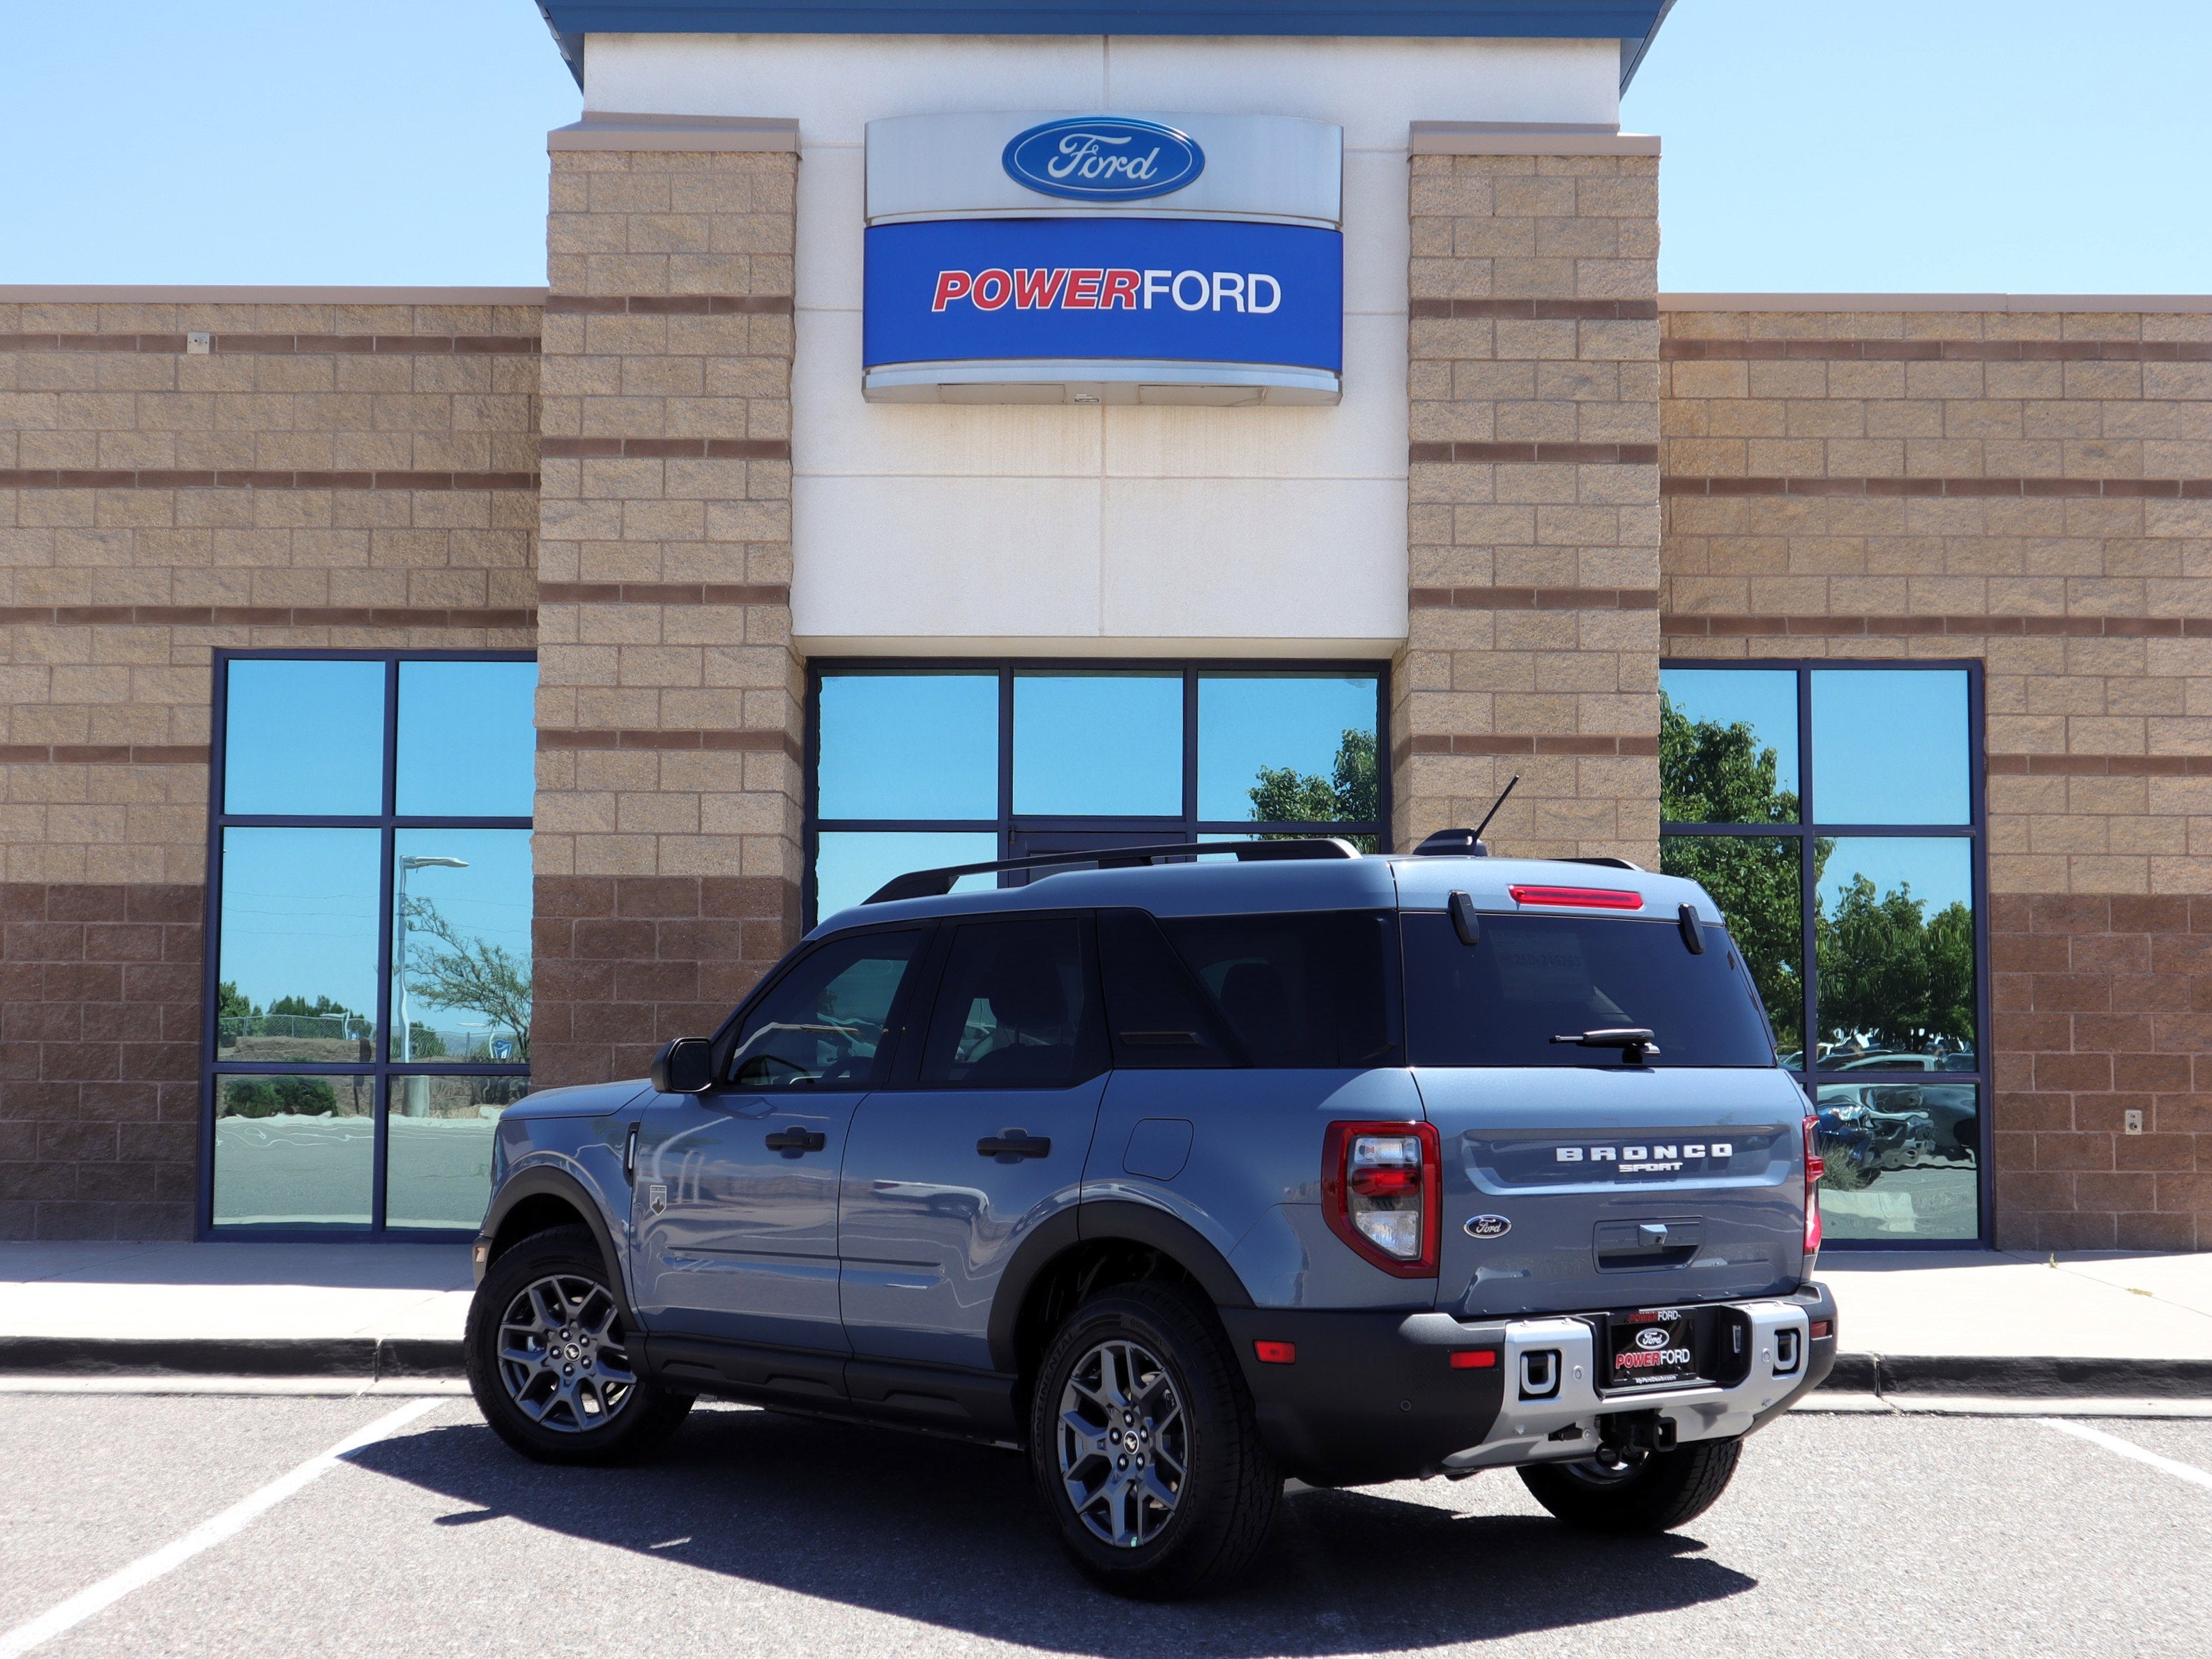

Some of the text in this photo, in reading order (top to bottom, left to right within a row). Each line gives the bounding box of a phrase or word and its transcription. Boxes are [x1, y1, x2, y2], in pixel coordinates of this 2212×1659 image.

[1048, 132, 1160, 181] Ford
[931, 268, 1281, 314] POWERFORD
[1556, 1143, 1733, 1162] BRONCO
[1619, 1162, 1684, 1172] SPORT
[1476, 1218, 1502, 1233] Ford
[1642, 1332, 1663, 1345] Ford
[1615, 1349, 1691, 1369] POWERFORD
[1035, 1330, 1076, 1462] CONTINENTAL
